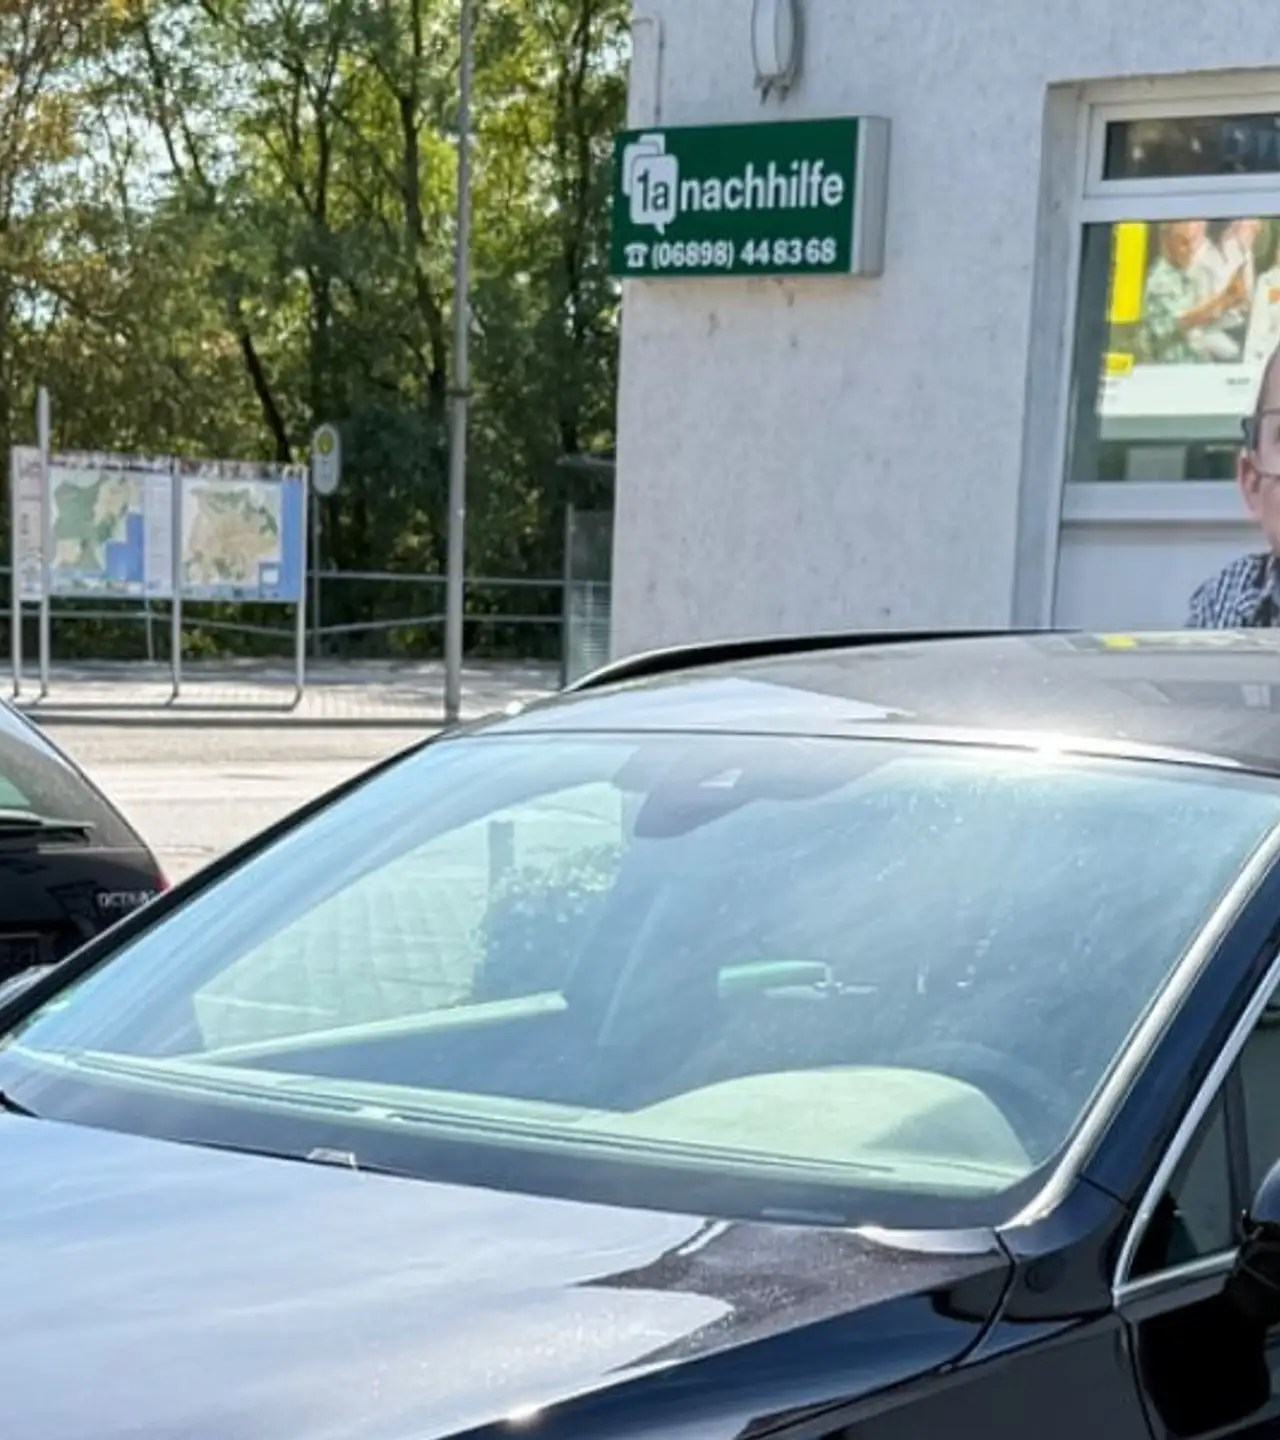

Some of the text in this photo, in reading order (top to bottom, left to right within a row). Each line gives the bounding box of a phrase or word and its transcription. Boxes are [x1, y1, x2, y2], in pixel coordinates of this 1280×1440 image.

[636, 159, 845, 213] 1a nachhilfe
[651, 239, 735, 269] (06898)
